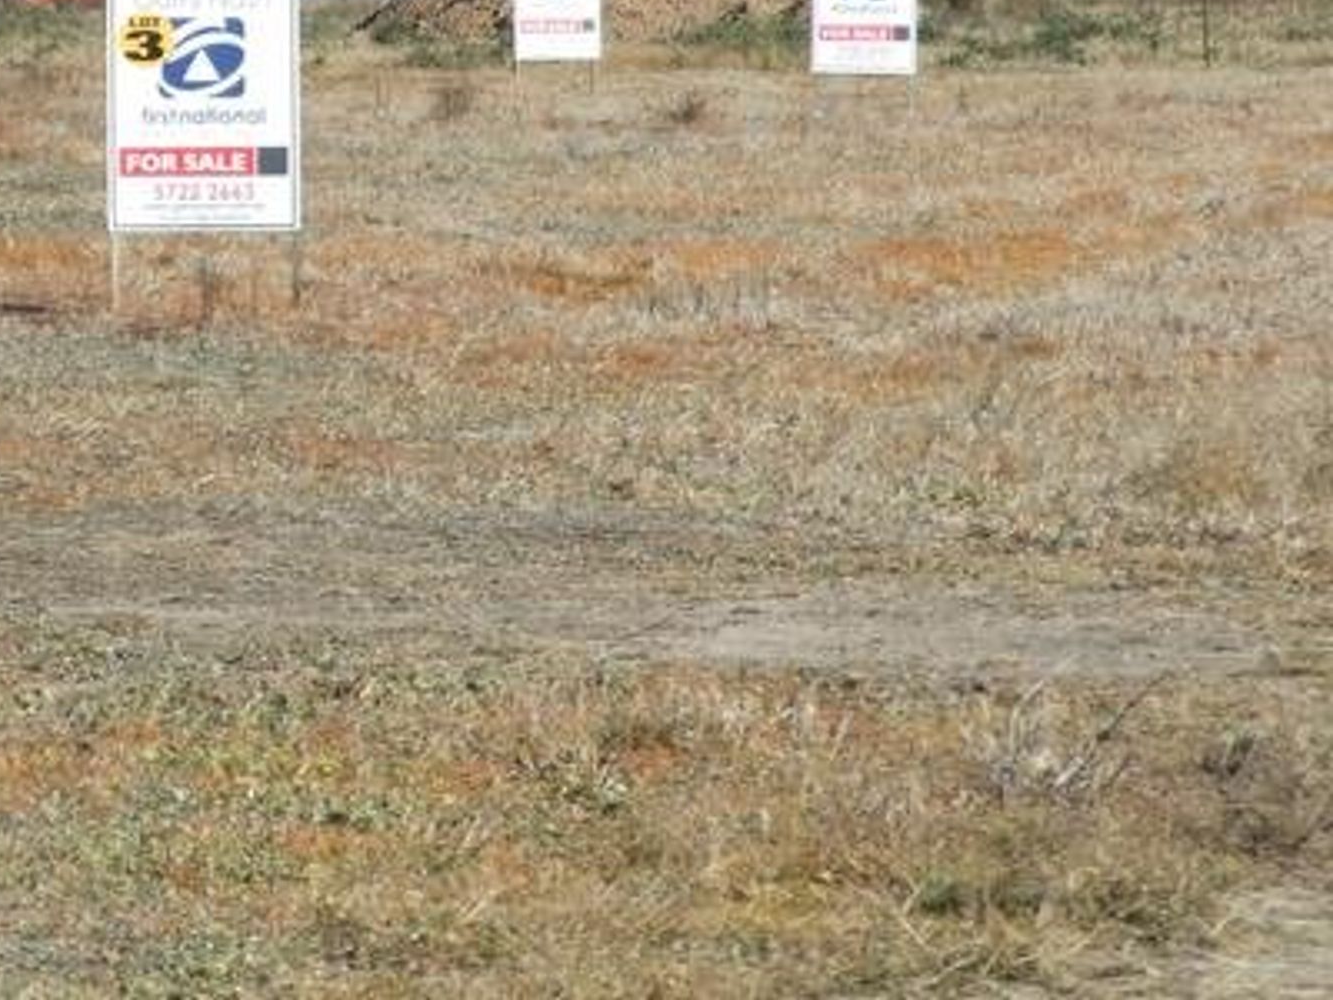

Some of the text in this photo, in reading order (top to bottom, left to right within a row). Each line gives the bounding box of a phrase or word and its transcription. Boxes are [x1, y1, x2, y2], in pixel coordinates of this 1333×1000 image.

[128, 16, 161, 28] LOT
[124, 29, 165, 62] 3
[125, 153, 248, 173] FOR SALE
